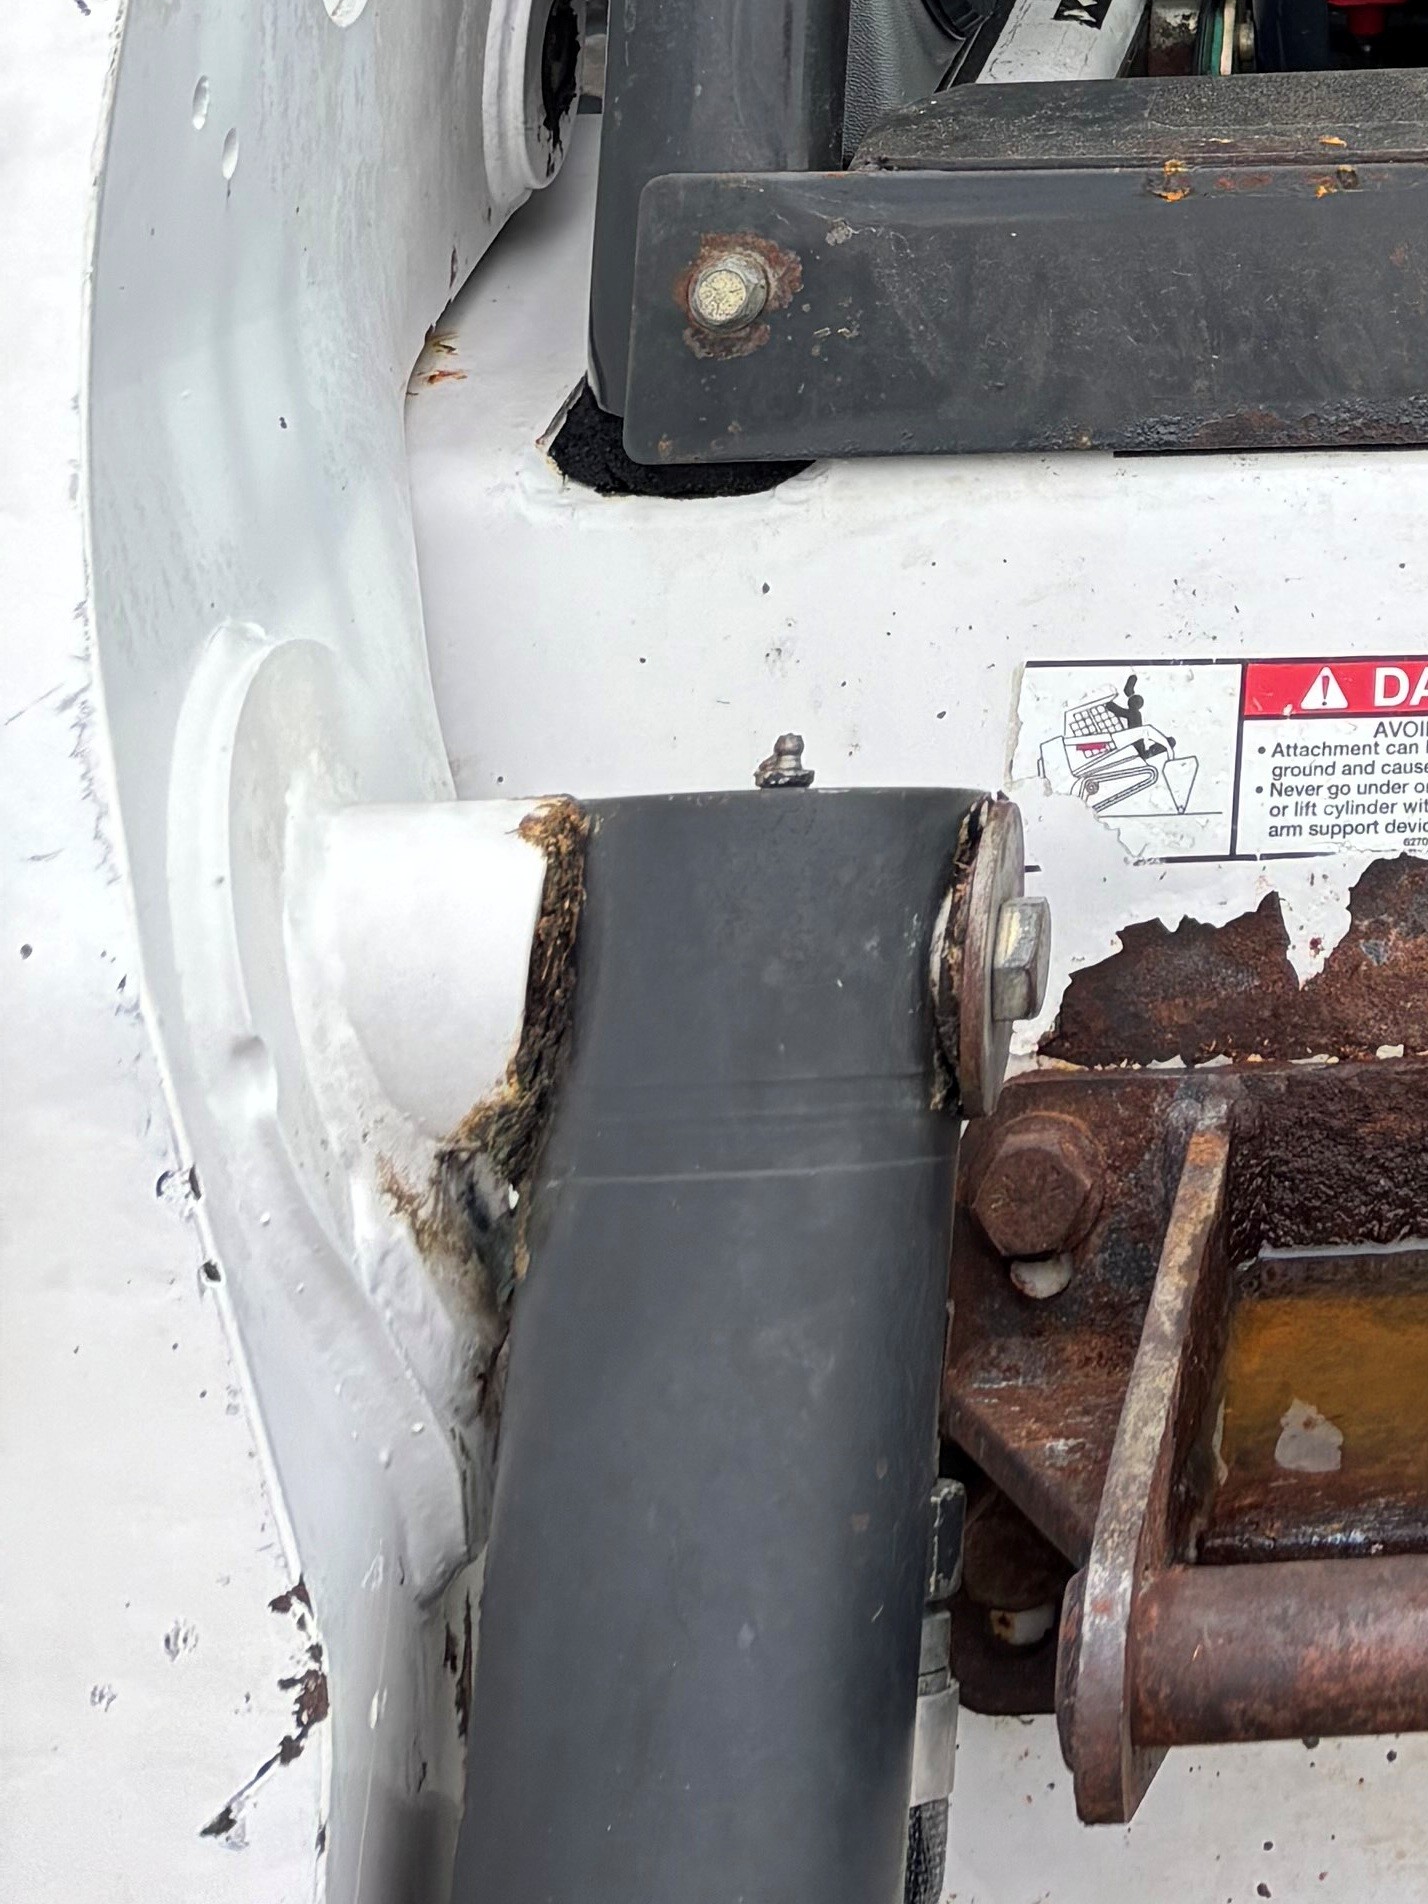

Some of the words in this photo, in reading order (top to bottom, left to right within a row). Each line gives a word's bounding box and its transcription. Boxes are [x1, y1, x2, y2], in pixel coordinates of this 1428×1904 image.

[1272, 741, 1379, 757] Attachment
[1386, 743, 1418, 755] can
[1272, 761, 1335, 781] ground
[1342, 760, 1375, 775] and
[1270, 782, 1323, 797] Never
[1327, 782, 1350, 799] go
[1358, 781, 1406, 795] under
[1270, 804, 1288, 817] or
[1295, 801, 1317, 816] lift
[1324, 800, 1397, 819] cylinder
[1269, 824, 1302, 837] arm
[1309, 820, 1378, 839] support
